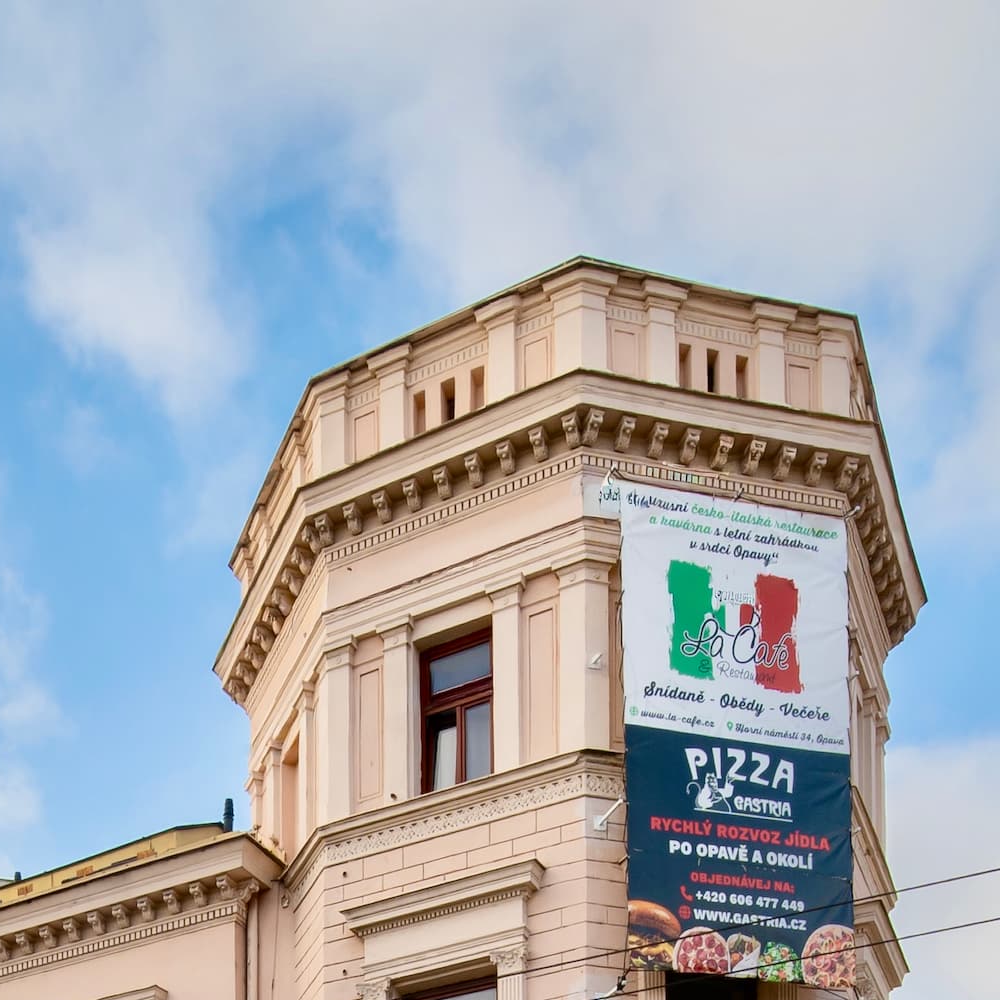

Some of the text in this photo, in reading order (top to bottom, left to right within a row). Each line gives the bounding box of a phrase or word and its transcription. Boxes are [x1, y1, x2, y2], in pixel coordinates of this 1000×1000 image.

[649, 515, 820, 553] a kavárna s letní zahrádkou
[774, 518, 840, 541] restaurace
[699, 541, 731, 556] srdci
[681, 617, 725, 660] La
[643, 682, 706, 704] Snídaně
[719, 694, 765, 717] Obědy
[779, 704, 831, 722] Večeře
[640, 709, 716, 728] www.la-cafe.cz
[735, 722, 763, 737] Horní
[763, 727, 799, 741] náměstí
[816, 734, 845, 747] Opava
[684, 746, 795, 794] PIZZA
[733, 795, 792, 818] GASTRIA
[650, 816, 830, 850] RYCHLÝ ROZVOZ JÍDLA
[669, 839, 813, 870] PO OPAVĚ A OKOLÍ
[690, 871, 771, 890] OBJEDNÁVEJ
[696, 890, 805, 912] +420 606 477 449
[693, 908, 807, 931] WWW.GASTRIA.CZ
